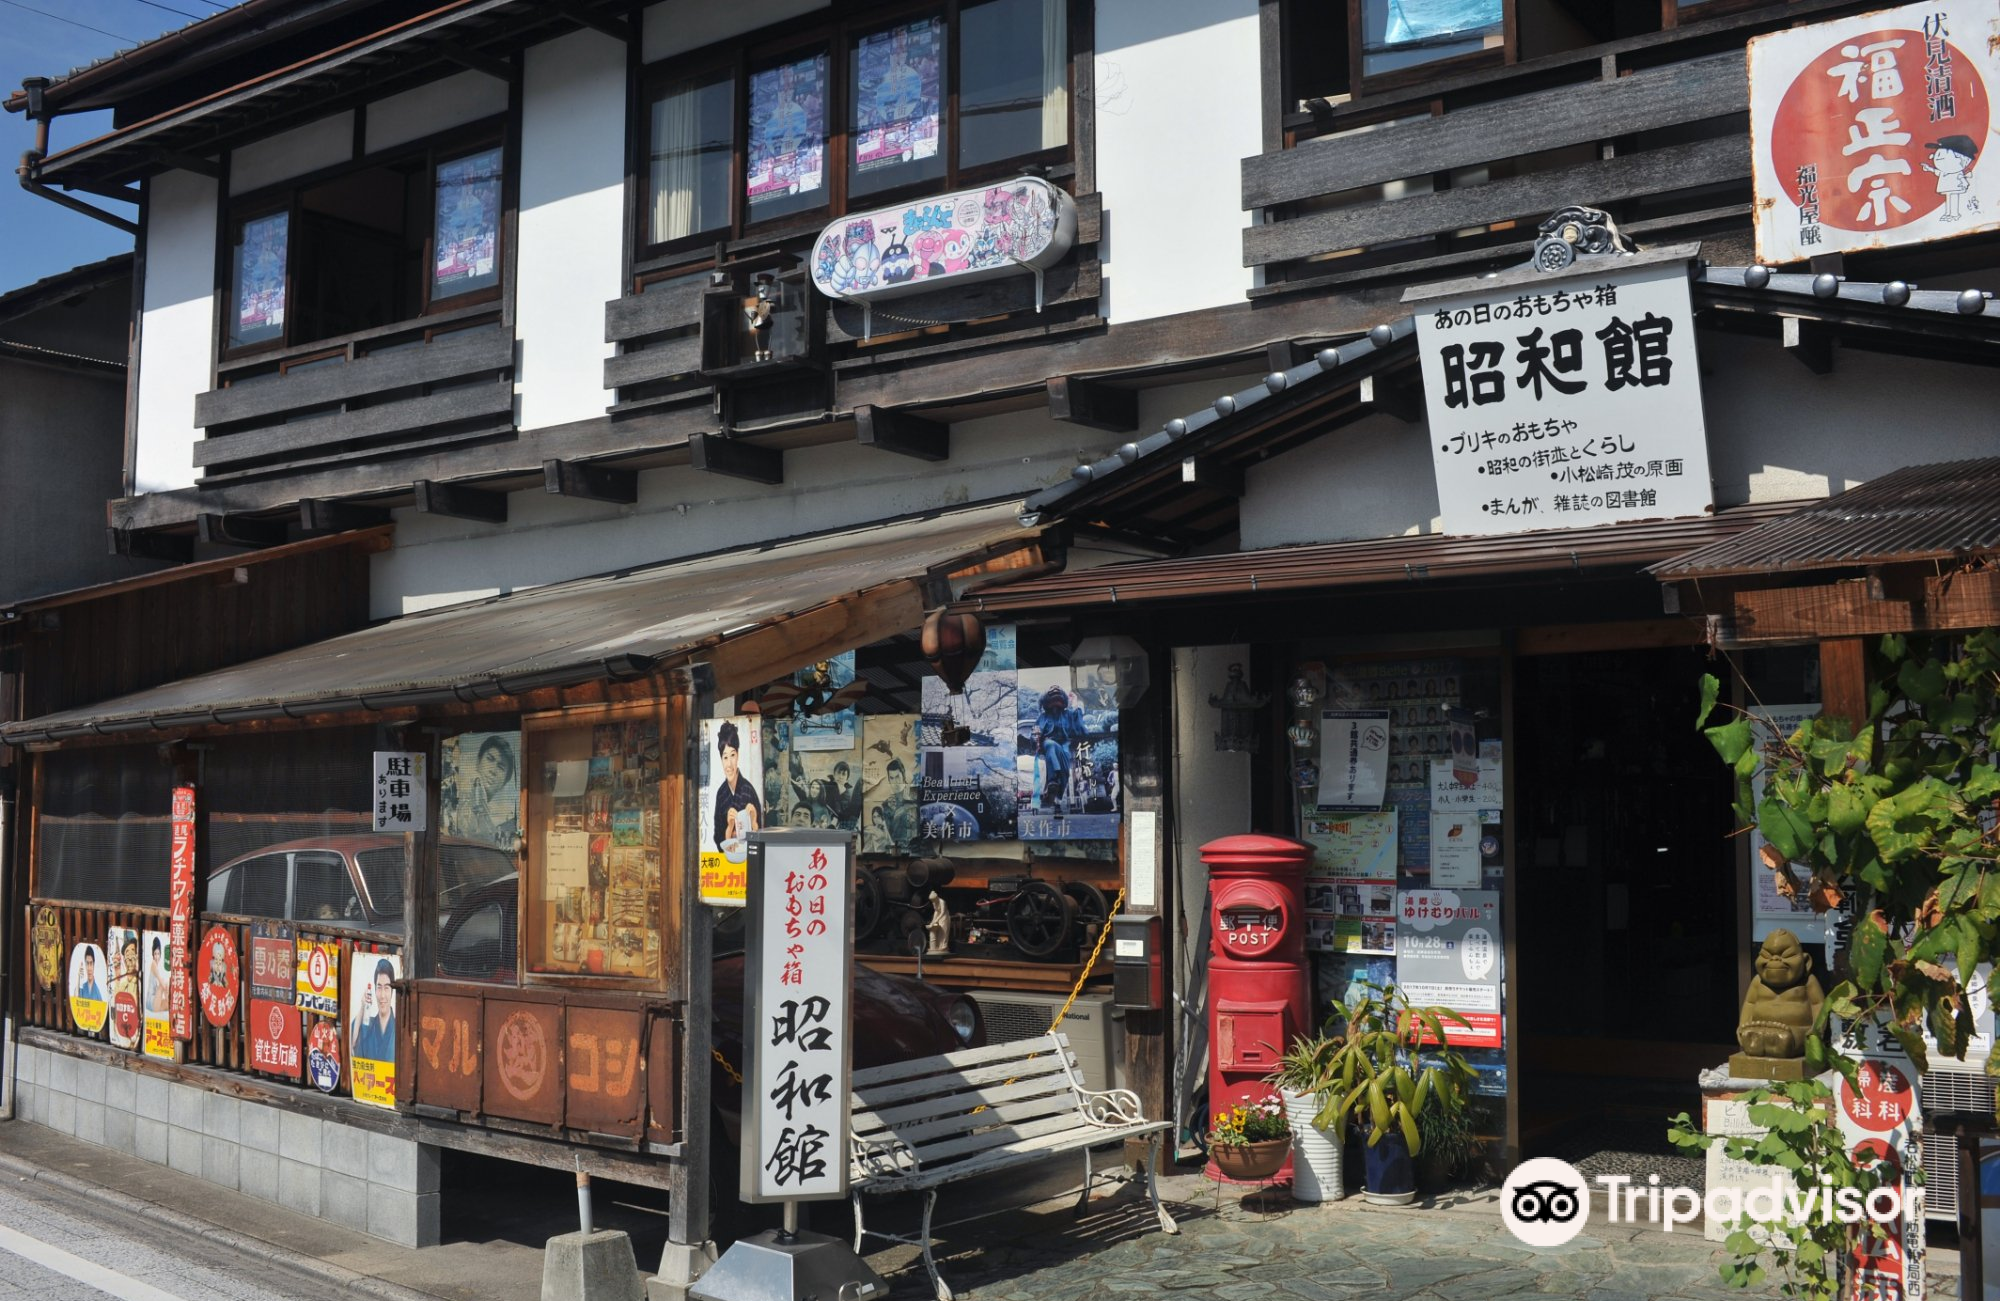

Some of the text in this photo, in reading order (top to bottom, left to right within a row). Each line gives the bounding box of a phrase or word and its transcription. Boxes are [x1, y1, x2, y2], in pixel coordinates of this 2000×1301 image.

[1922, 12, 1956, 123] 伏見清酒
[1827, 39, 1912, 226] 福正宗
[1434, 283, 1618, 331] あの日のおもちゃ箱
[1439, 311, 1674, 409] 昭和館
[1449, 417, 1578, 455] ブリキのおもちゃ
[1487, 433, 1635, 476] 昭和の街並とくらし
[1558, 457, 1684, 483] 小松崎茂の原画
[378, 774, 387, 827] あります
[386, 757, 412, 822] 駐車場
[923, 790, 981, 802] Experience
[923, 821, 973, 839] 美作市
[1021, 819, 1071, 838] 美作市
[701, 857, 721, 868] 大塚の
[806, 847, 828, 937] あの日の
[1404, 906, 1481, 920] ゆけむりバル
[780, 871, 805, 986] おもちゃ箱
[1228, 932, 1269, 945] POST
[765, 995, 834, 1187] 昭和館
